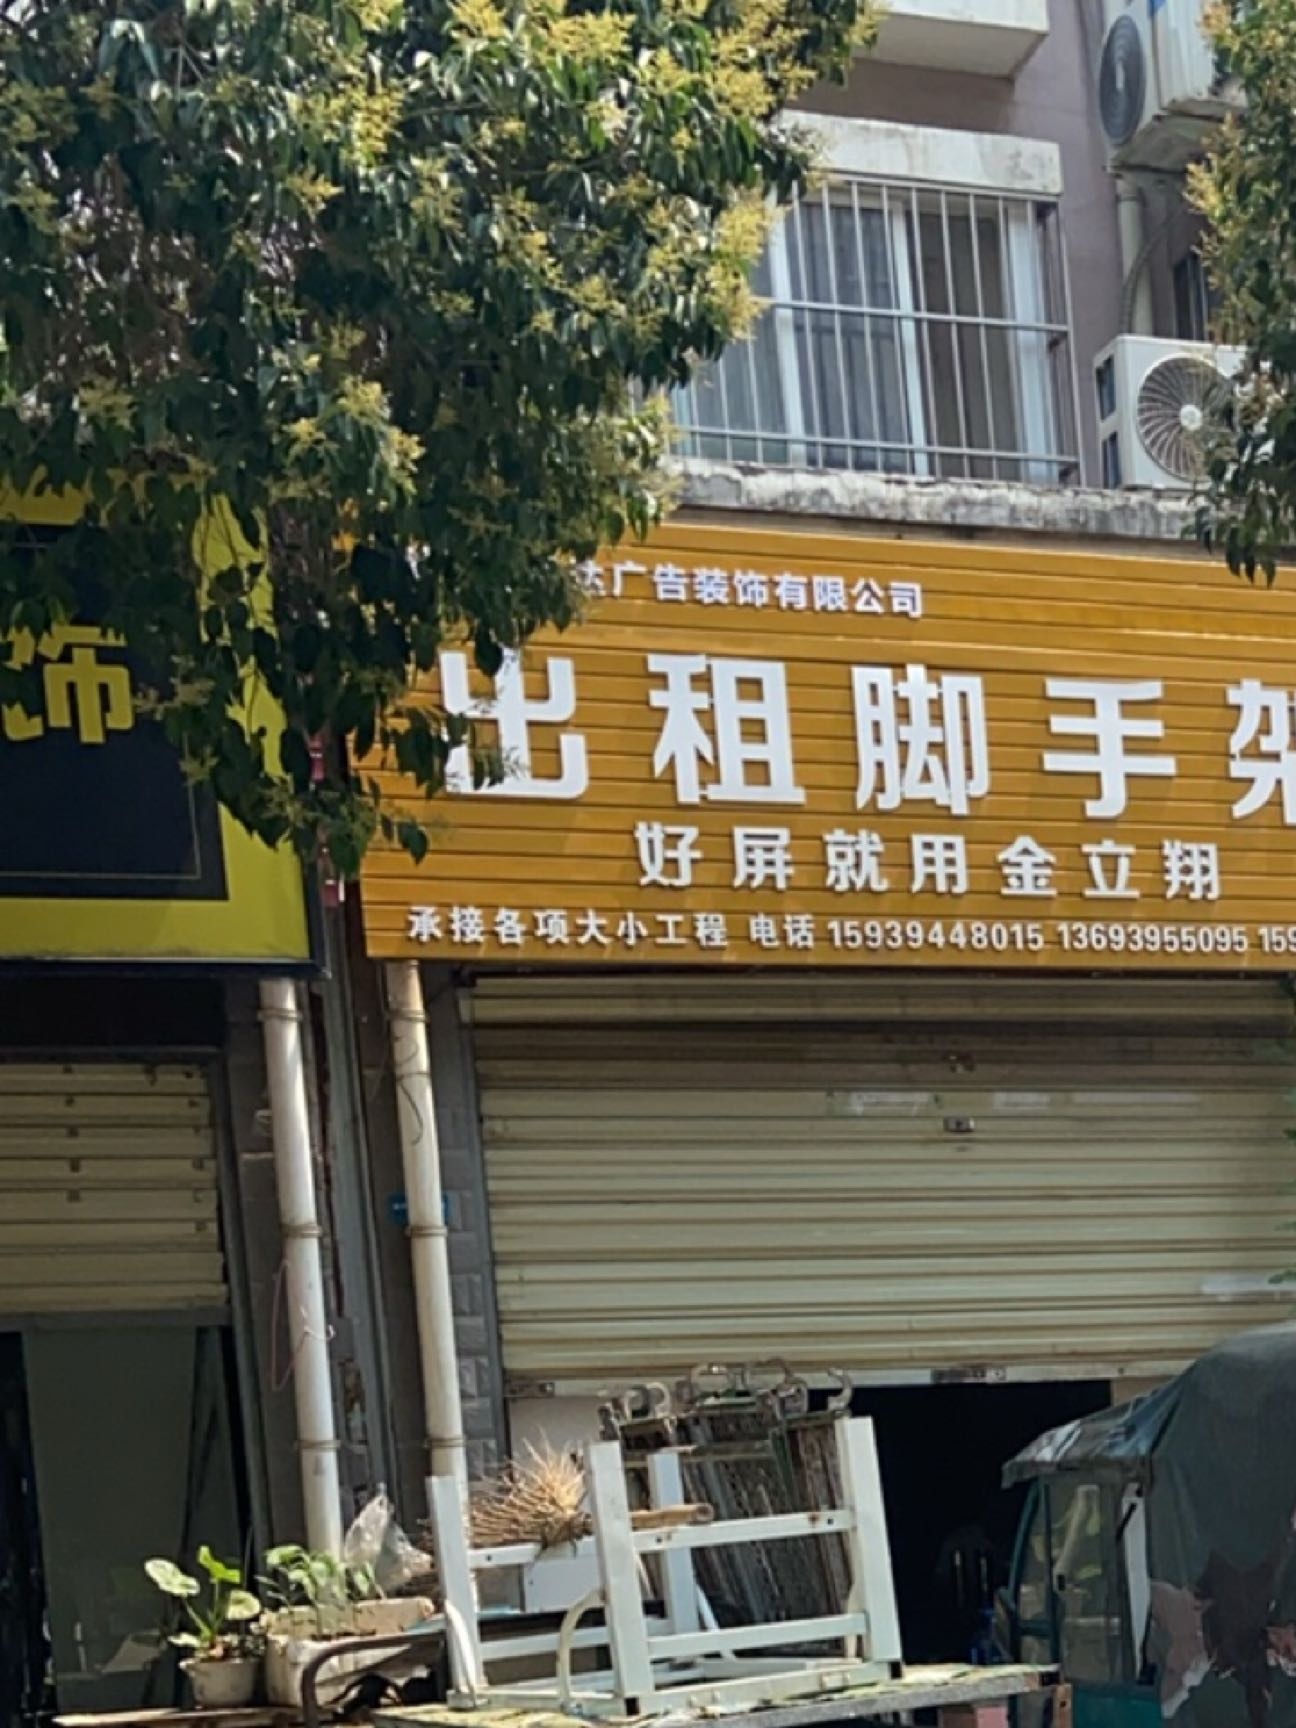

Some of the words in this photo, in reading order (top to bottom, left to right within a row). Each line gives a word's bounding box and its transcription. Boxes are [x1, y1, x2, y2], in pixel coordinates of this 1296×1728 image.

[634, 821, 1222, 901] 好屏就用金立翔
[407, 905, 728, 948] 承接各项大小工程
[748, 912, 815, 949] 电话
[828, 919, 1044, 952] 15939448015
[1058, 922, 1249, 955] 13693955095
